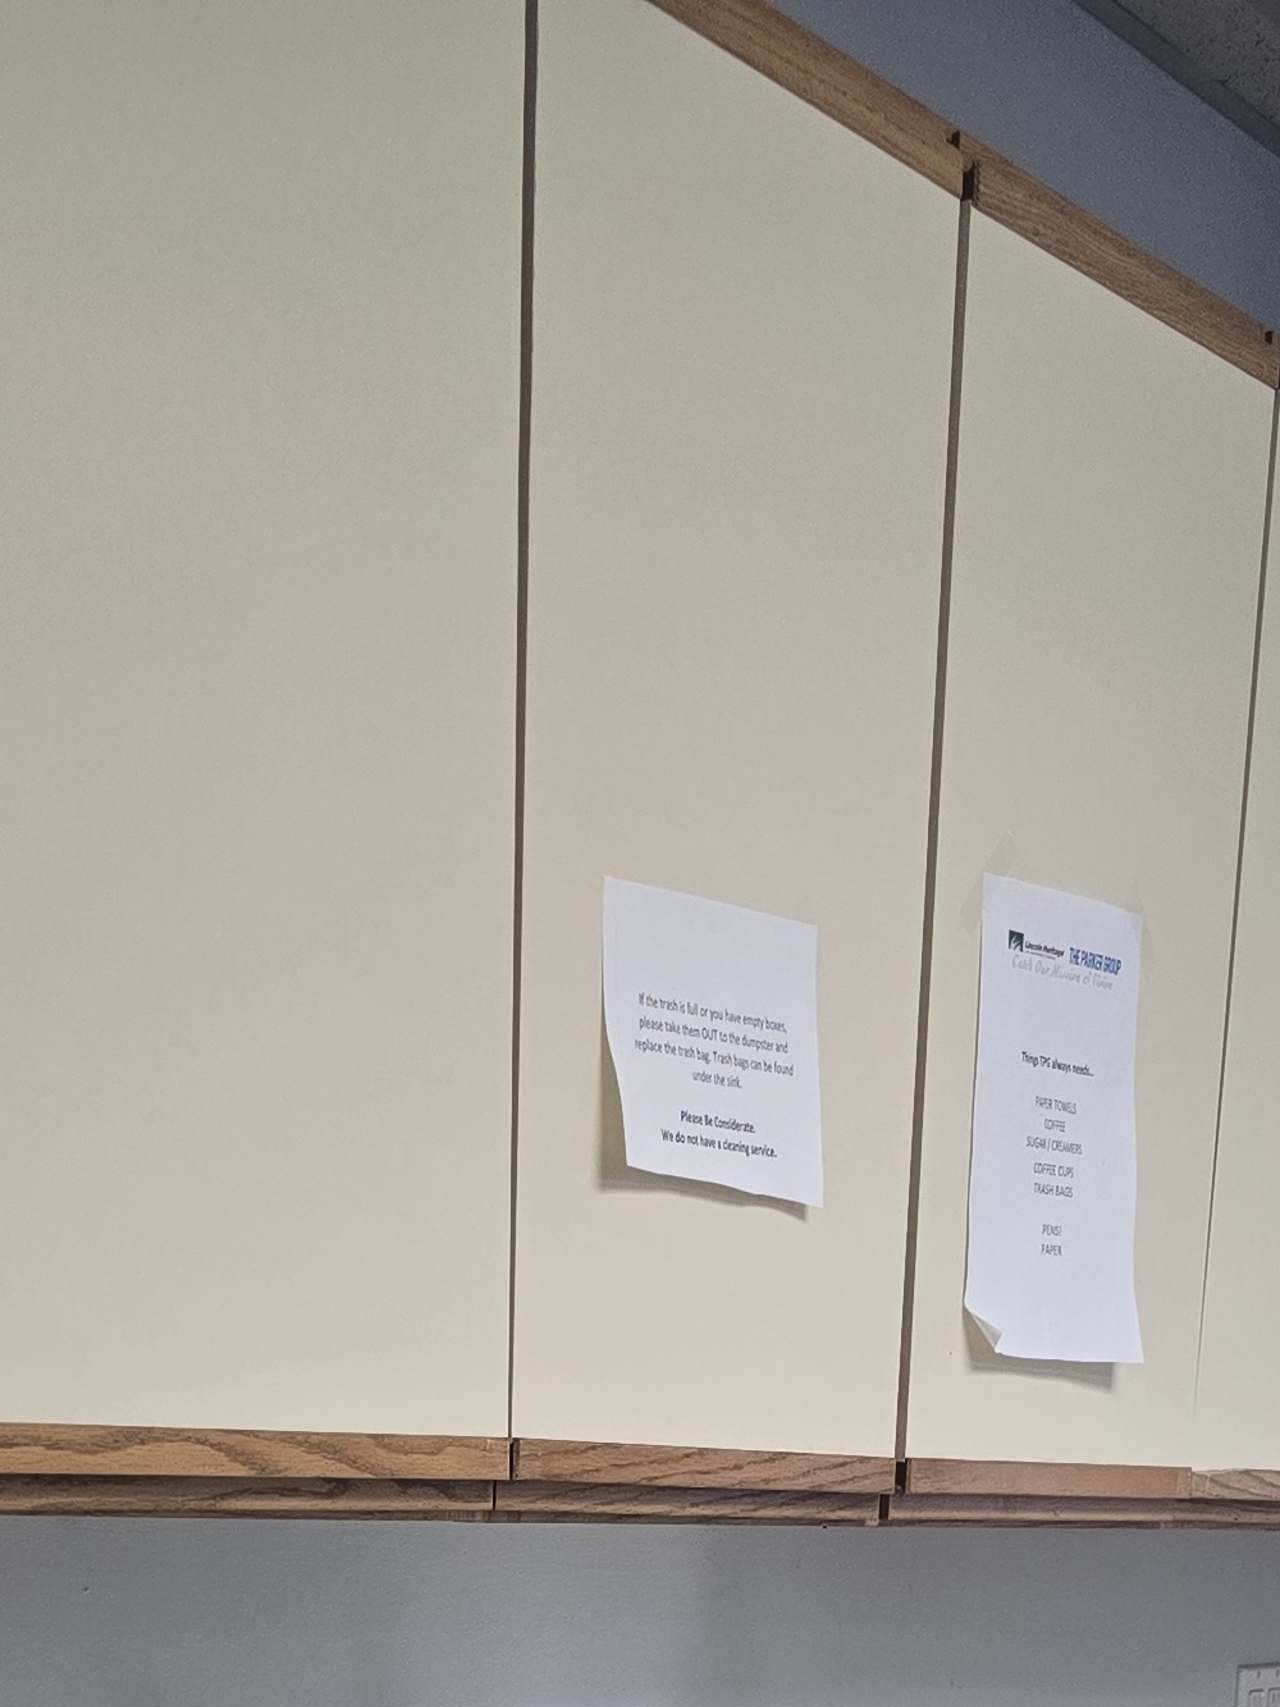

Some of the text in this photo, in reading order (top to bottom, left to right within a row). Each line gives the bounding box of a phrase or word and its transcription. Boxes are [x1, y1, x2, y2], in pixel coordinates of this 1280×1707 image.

[638, 992, 644, 1006] If
[646, 994, 658, 1008] the
[659, 998, 678, 1011] trash
[679, 1001, 685, 1014] is
[686, 1002, 698, 1016] full
[700, 1006, 708, 1016] or
[710, 1010, 723, 1021] you
[724, 1009, 741, 1024] have
[743, 1015, 764, 1031] empty
[639, 1016, 789, 1054] please take them OUT to the dumpster and
[634, 1039, 662, 1054] replace
[664, 1042, 676, 1055] the
[678, 1046, 695, 1058] trash
[713, 1050, 732, 1065] Trash
[734, 1055, 749, 1071] bags
[750, 1060, 762, 1071] can
[763, 1060, 772, 1073] be
[774, 1061, 794, 1077] found
[692, 1070, 742, 1089] under the sink.
[680, 1110, 703, 1125] Please
[704, 1114, 713, 1127] Be
[661, 1128, 674, 1142] We
[676, 1131, 686, 1144] do
[686, 1134, 699, 1146] not
[700, 1134, 716, 1149] have
[723, 1138, 750, 1157] cleaning
[751, 1144, 778, 1157] service.
[1041, 1244, 1062, 1256] PAPER
